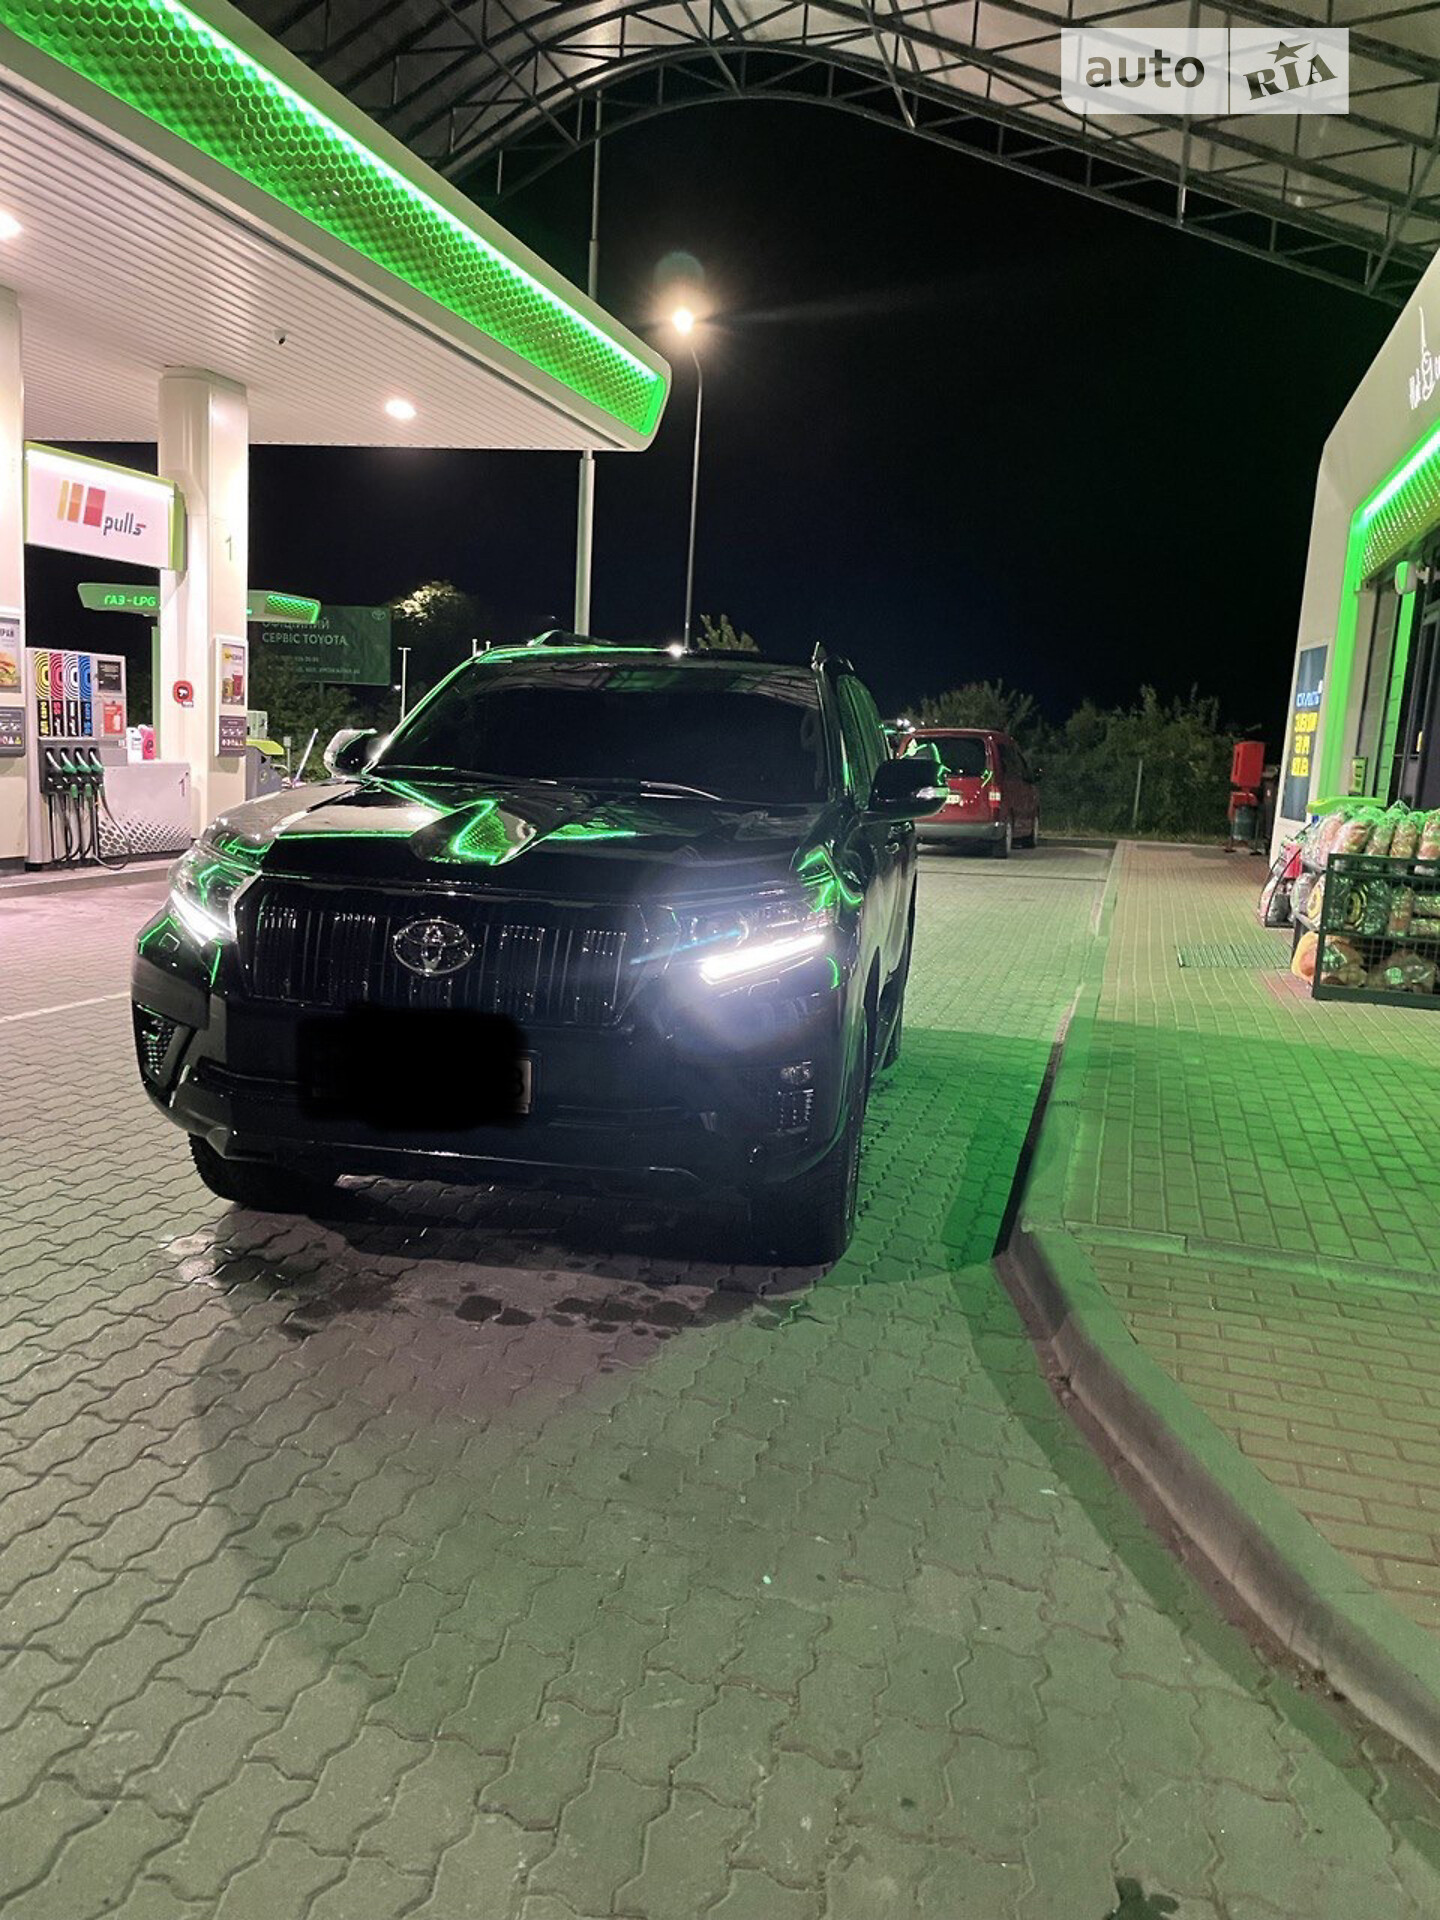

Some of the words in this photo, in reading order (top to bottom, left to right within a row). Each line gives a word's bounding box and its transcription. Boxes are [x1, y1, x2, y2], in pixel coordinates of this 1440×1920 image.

[103, 512, 146, 536] pulls
[225, 535, 232, 561] 1
[262, 632, 301, 644] СЕРВІС
[303, 633, 349, 646] TOYOTA
[178, 778, 185, 797] 1
